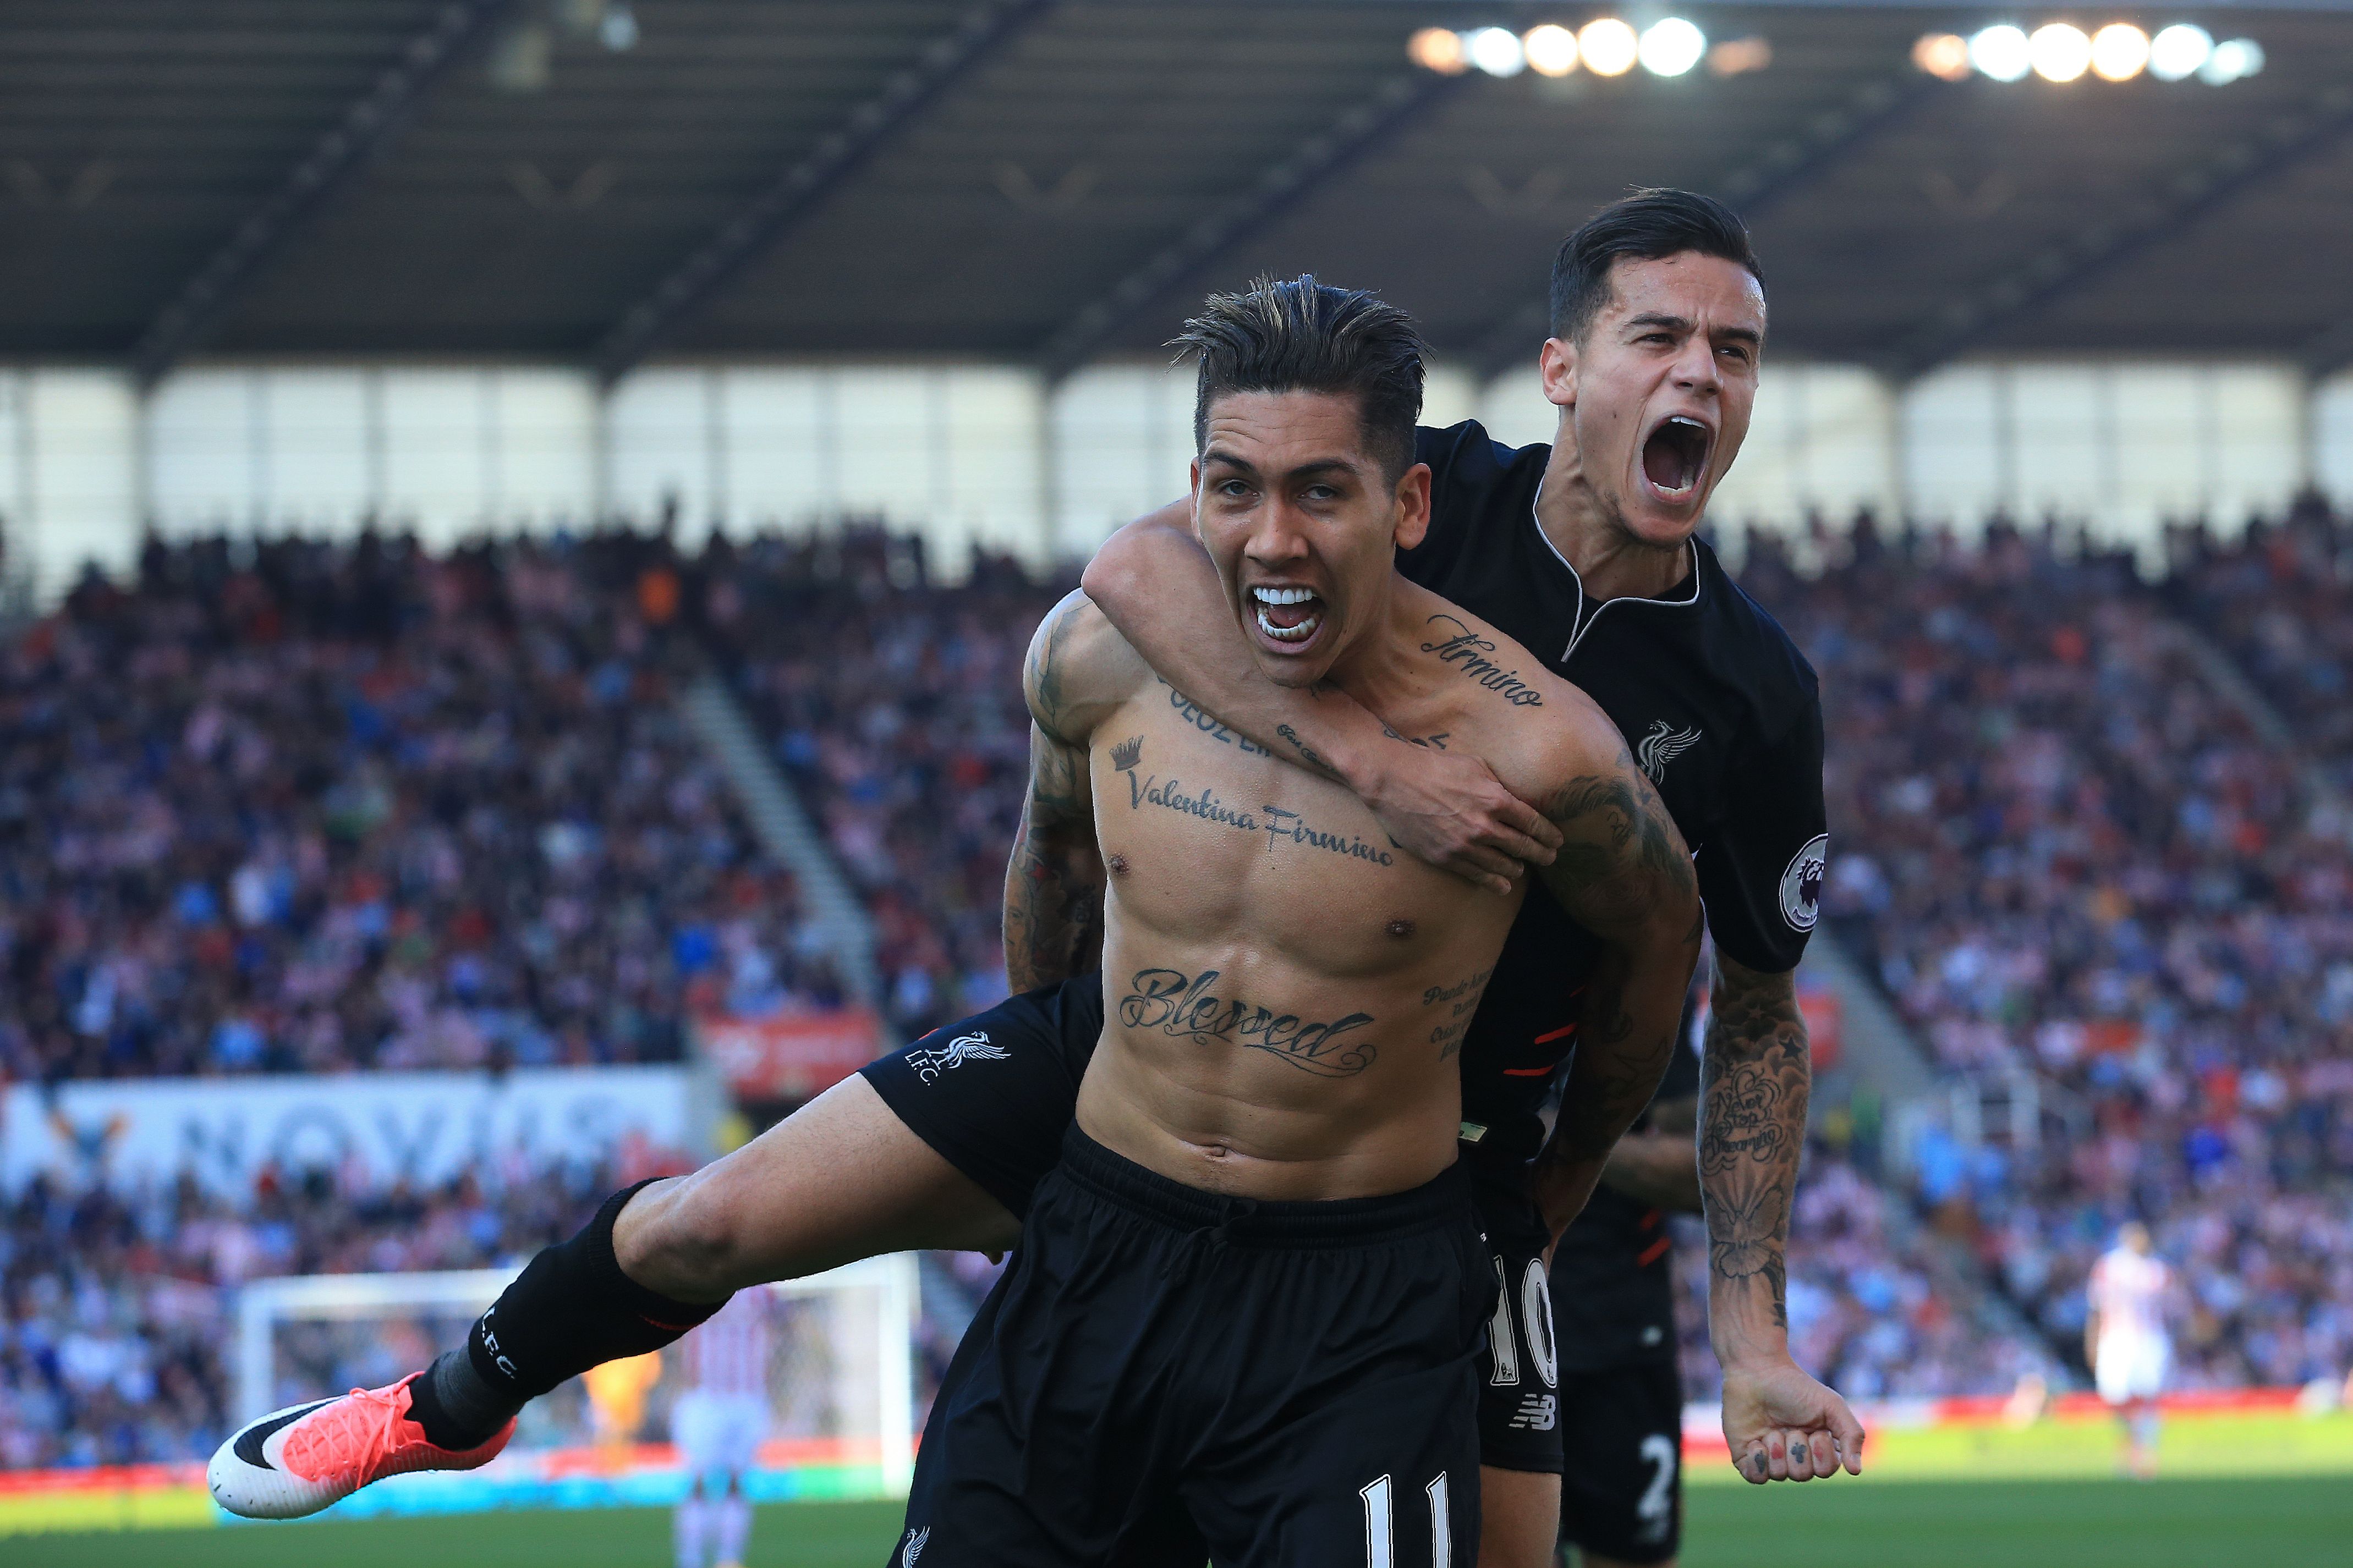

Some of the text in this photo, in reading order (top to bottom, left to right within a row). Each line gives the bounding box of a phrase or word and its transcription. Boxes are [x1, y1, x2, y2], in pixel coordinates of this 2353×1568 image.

[1127, 769, 1393, 867] Valentina Firmino
[1119, 967, 1375, 1063] Blessed
[1488, 1254, 1558, 1388] 10
[1359, 1471, 1451, 1568] 11
[1636, 1433, 1678, 1522] 2
